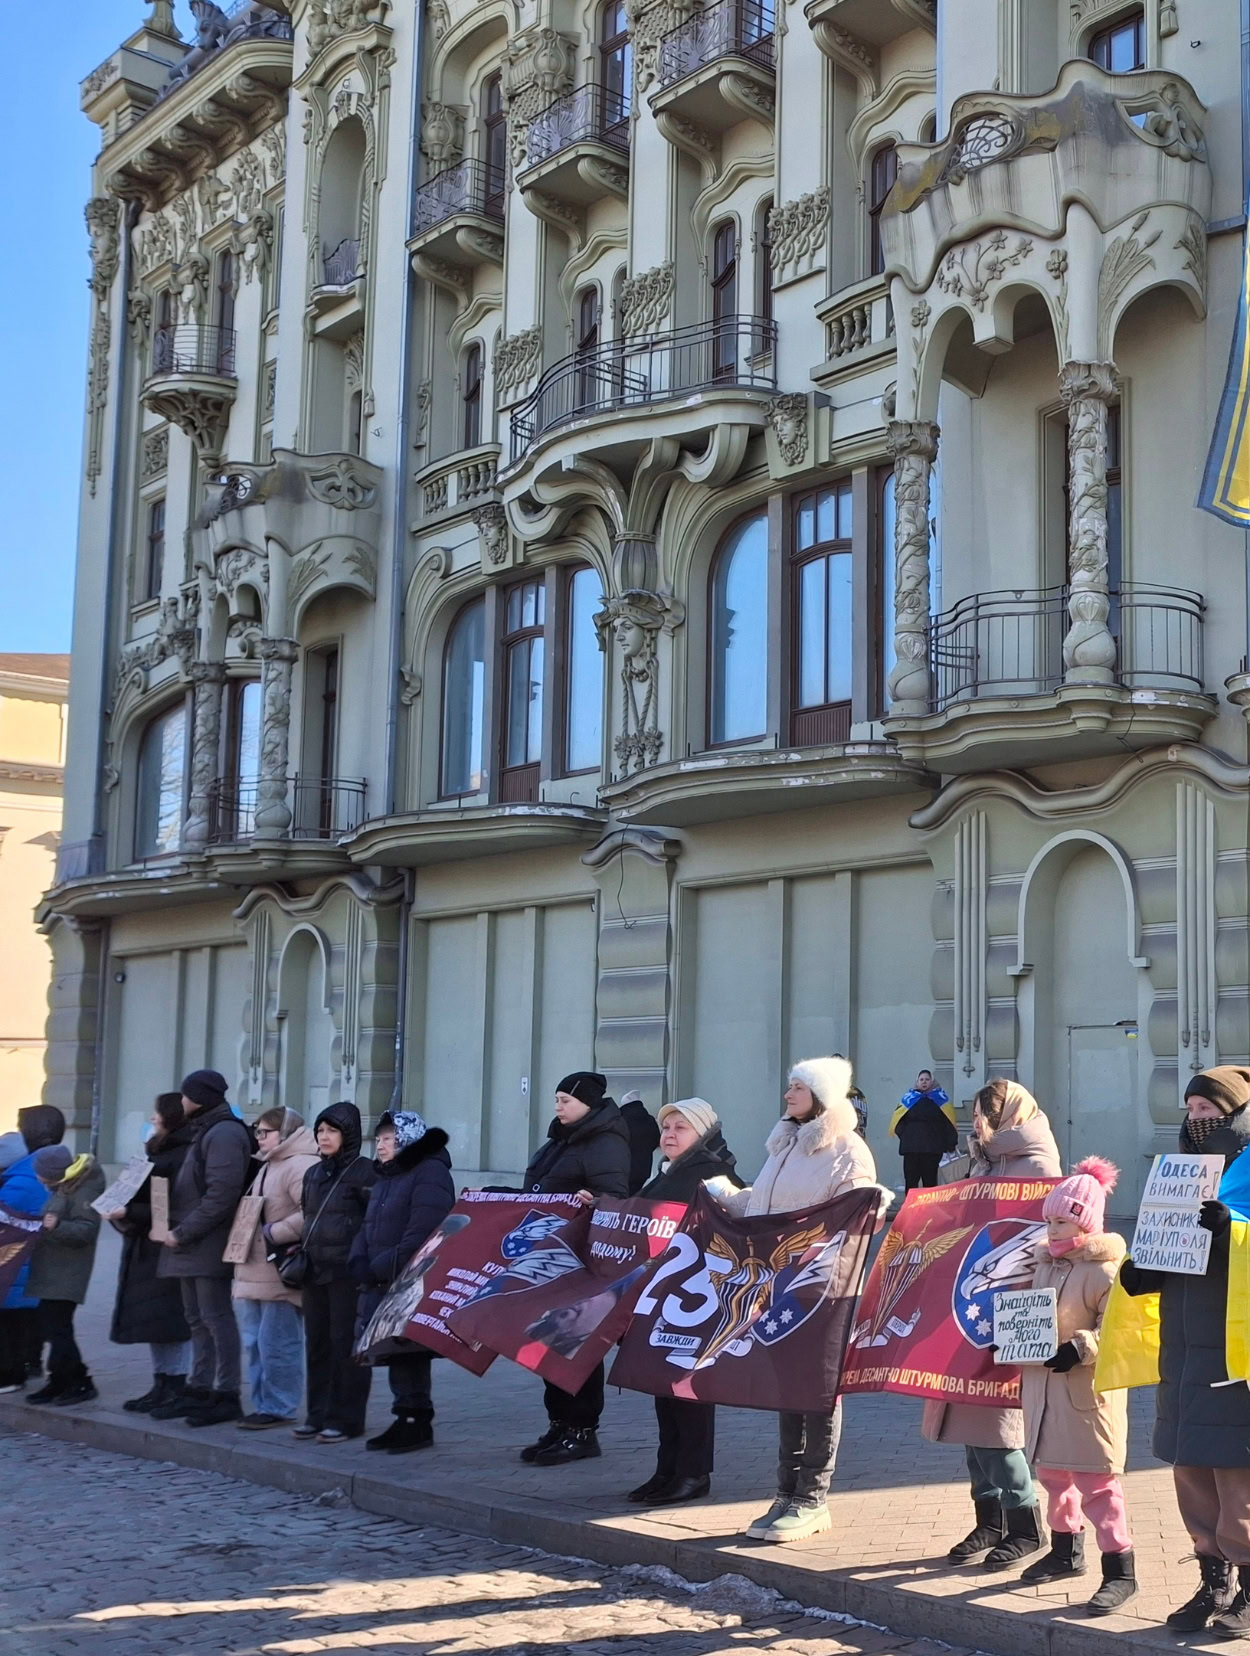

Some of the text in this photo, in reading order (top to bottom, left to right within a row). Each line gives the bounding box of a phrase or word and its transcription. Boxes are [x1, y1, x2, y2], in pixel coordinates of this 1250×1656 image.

[1161, 1161, 1208, 1179] ОДЕСА
[959, 1183, 1019, 1201] ШТУРМОВІ
[1021, 1181, 1056, 1201] ВІЙС
[621, 1214, 677, 1239] ГЕРОЇВ
[1136, 1229, 1208, 1250] МАРІУПОЛЯ
[633, 1232, 733, 1328] 25
[995, 1292, 1052, 1312] Знайдіть
[998, 1314, 1053, 1332] поверніть
[655, 1334, 695, 1346] ЗАВЖДИ
[899, 1368, 964, 1394] ШТУРМОВА
[968, 1380, 1020, 1400] БРИГАД
